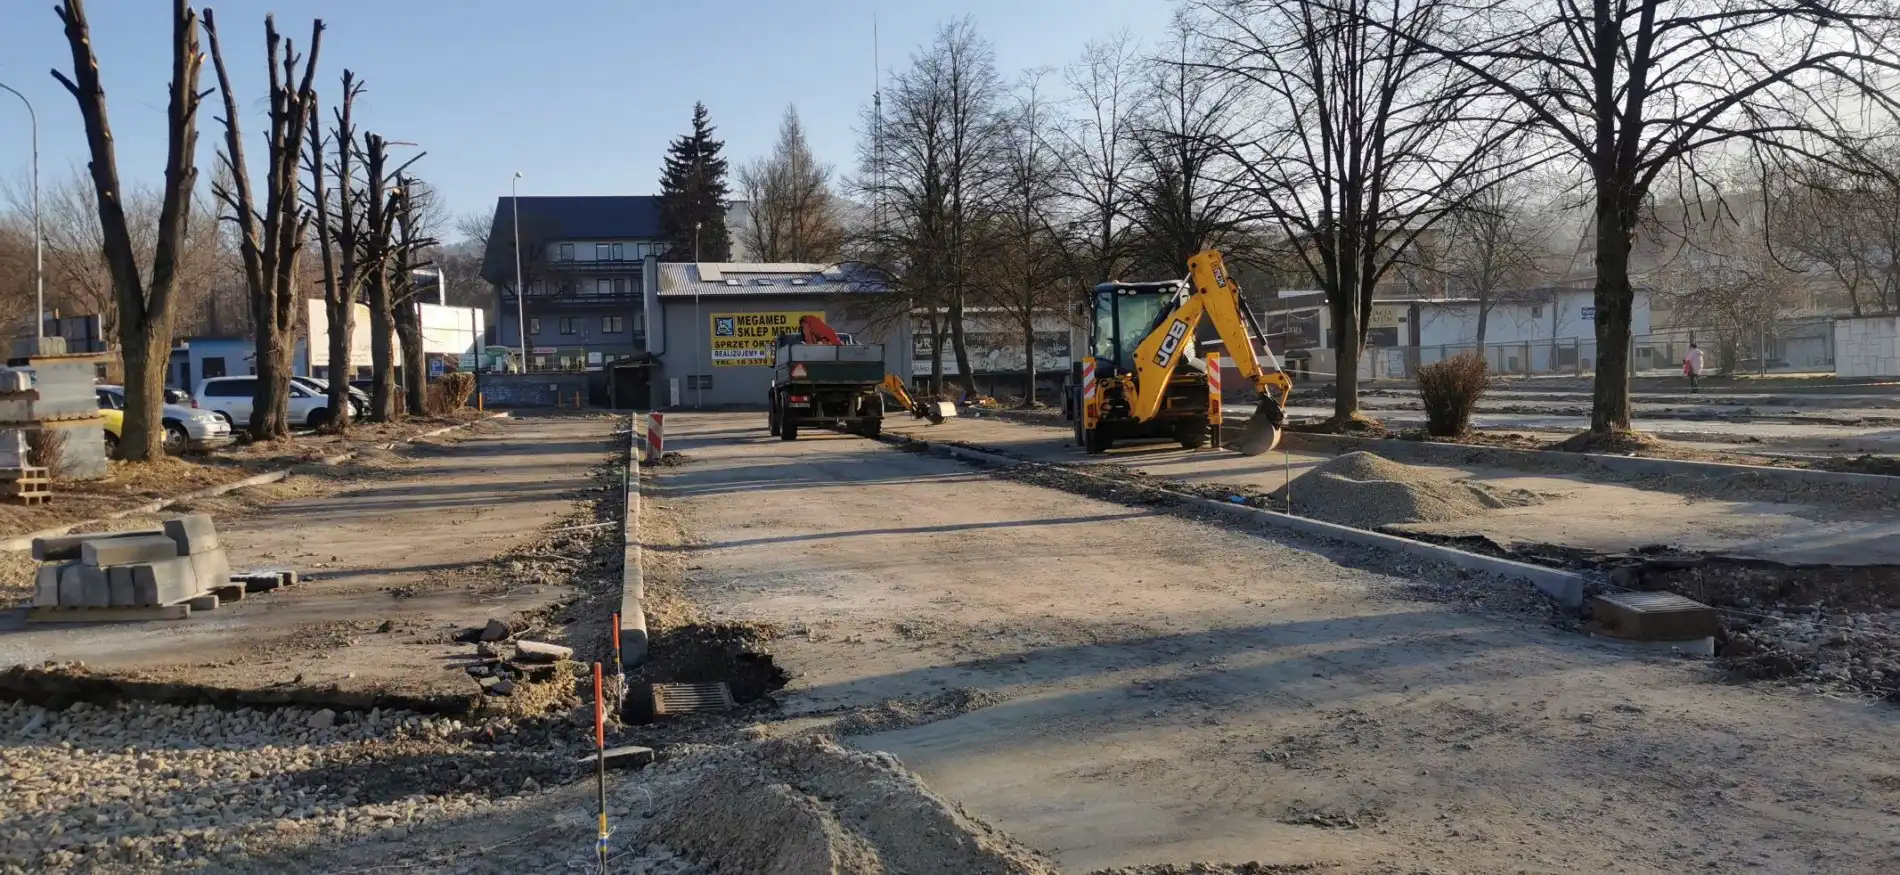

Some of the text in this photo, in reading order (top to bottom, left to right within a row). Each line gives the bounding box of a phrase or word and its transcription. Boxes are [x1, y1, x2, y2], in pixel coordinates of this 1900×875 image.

[737, 315, 787, 326] MEGAMED
[737, 326, 801, 337] SKLEP MEDY
[1157, 320, 1187, 367] JCB
[714, 350, 757, 358] REALIZUJEMY
